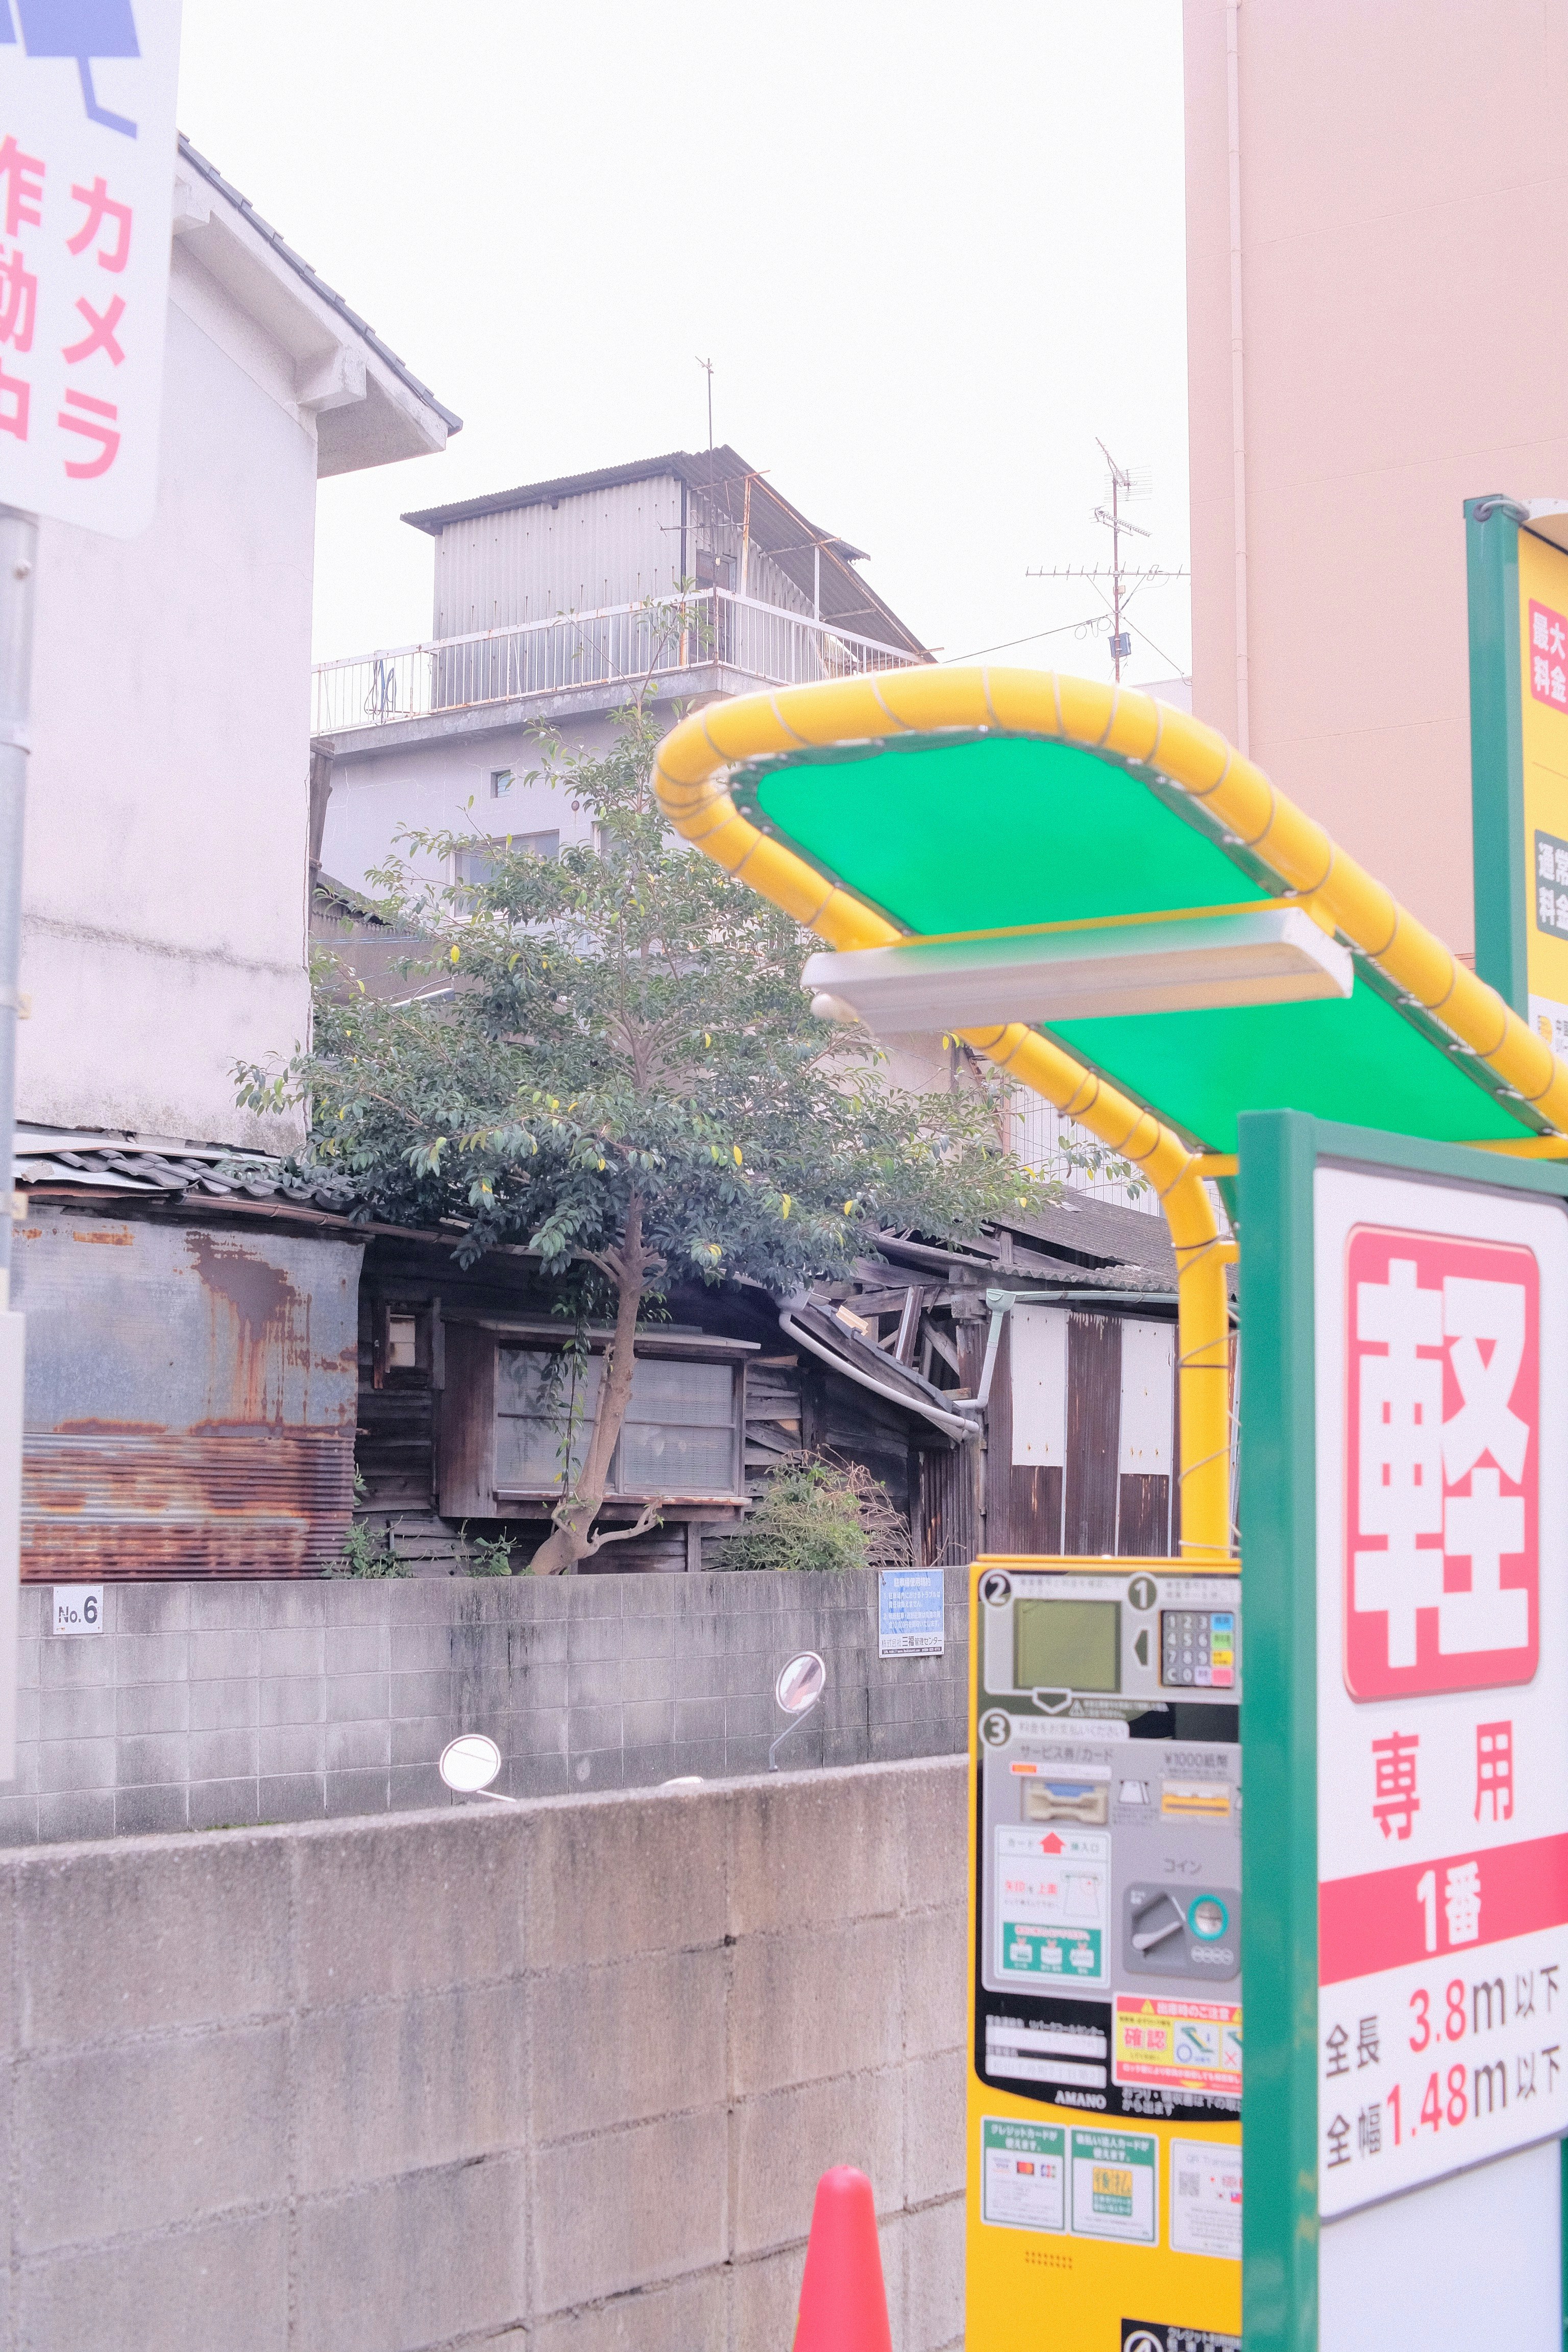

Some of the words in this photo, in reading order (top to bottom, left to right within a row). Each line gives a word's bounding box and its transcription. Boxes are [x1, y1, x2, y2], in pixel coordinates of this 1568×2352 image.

[58, 177, 133, 480] カメラ
[1533, 611, 1566, 660] 最大
[1533, 655, 1566, 703] 料金
[1538, 841, 1568, 886] 通常
[1538, 887, 1568, 930] 料金
[1354, 1257, 1530, 1670] 軽
[59, 1596, 97, 1624] No.6
[988, 1576, 1006, 1604] 2
[1135, 1580, 1150, 1609] 1
[882, 1636, 942, 1648] 株式会社三福管理センター
[988, 1714, 1004, 1742] 3
[1370, 1720, 1515, 1842] 専用
[1164, 1857, 1203, 1875] コイン
[1415, 1859, 1482, 1953] 1番
[1325, 2016, 1380, 2079] 全長
[1408, 1964, 1561, 2054] 3.8m以下
[1055, 2089, 1107, 2111] AMANO
